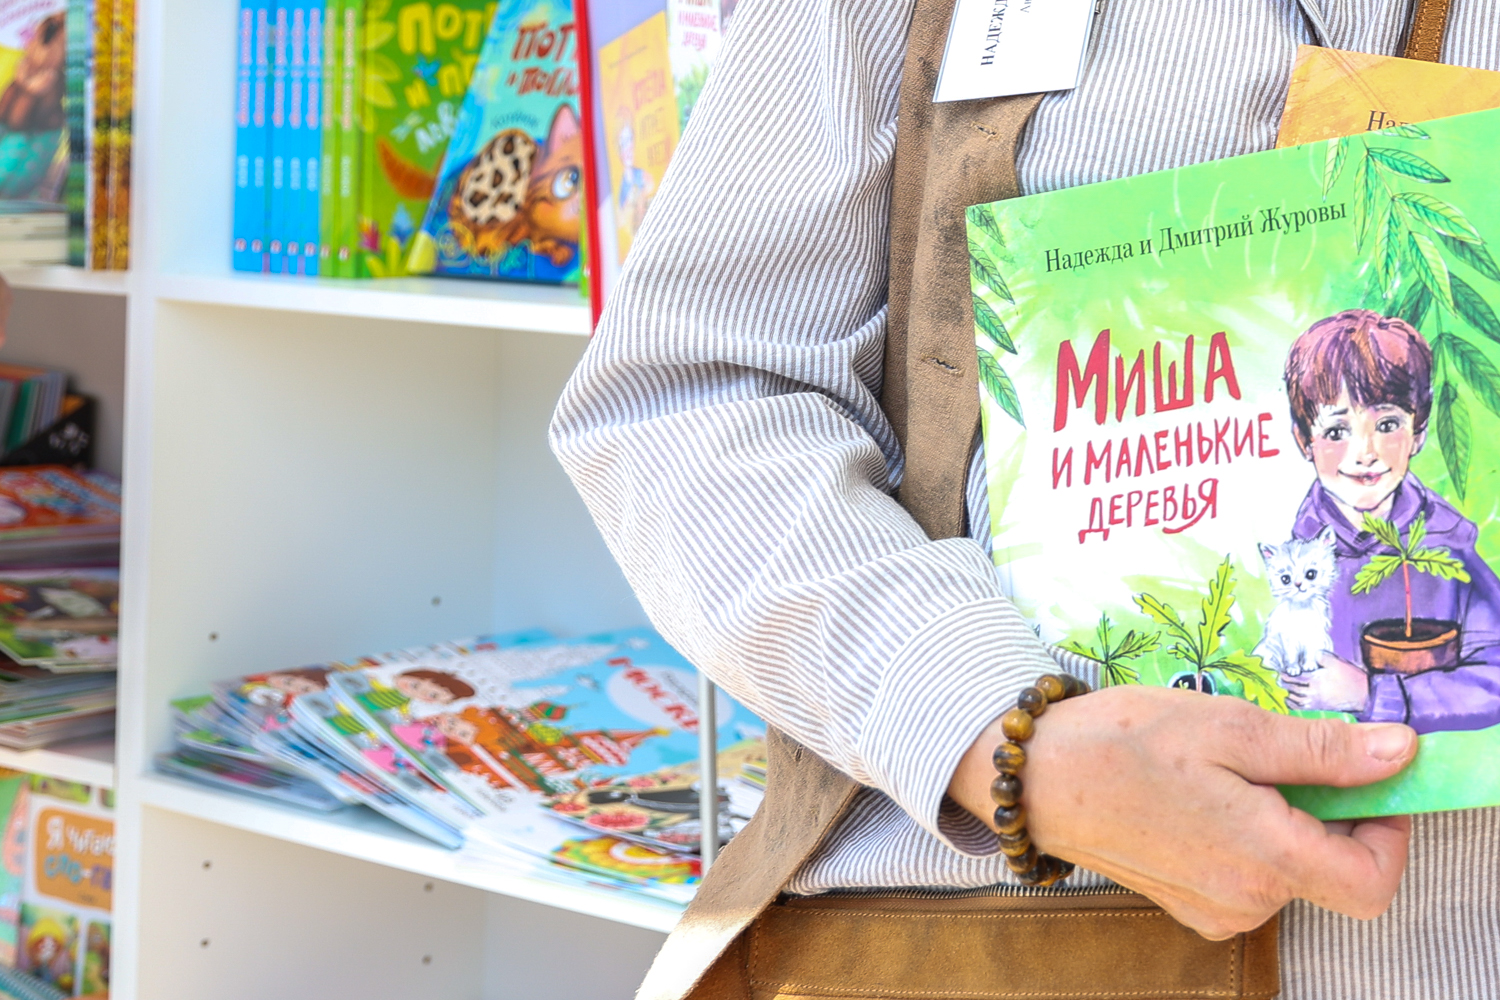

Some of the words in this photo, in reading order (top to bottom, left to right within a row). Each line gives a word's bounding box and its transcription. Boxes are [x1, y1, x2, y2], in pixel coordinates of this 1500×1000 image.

[1044, 241, 1134, 273] Надежда
[1139, 238, 1153, 256] и
[1158, 214, 1254, 256] Дмитрий
[1259, 202, 1347, 235] Журовы
[1052, 446, 1073, 490] И
[1083, 412, 1280, 485] МАЛЕНЬКИЕ
[1077, 478, 1219, 544] ДЕРЕВЬЯ
